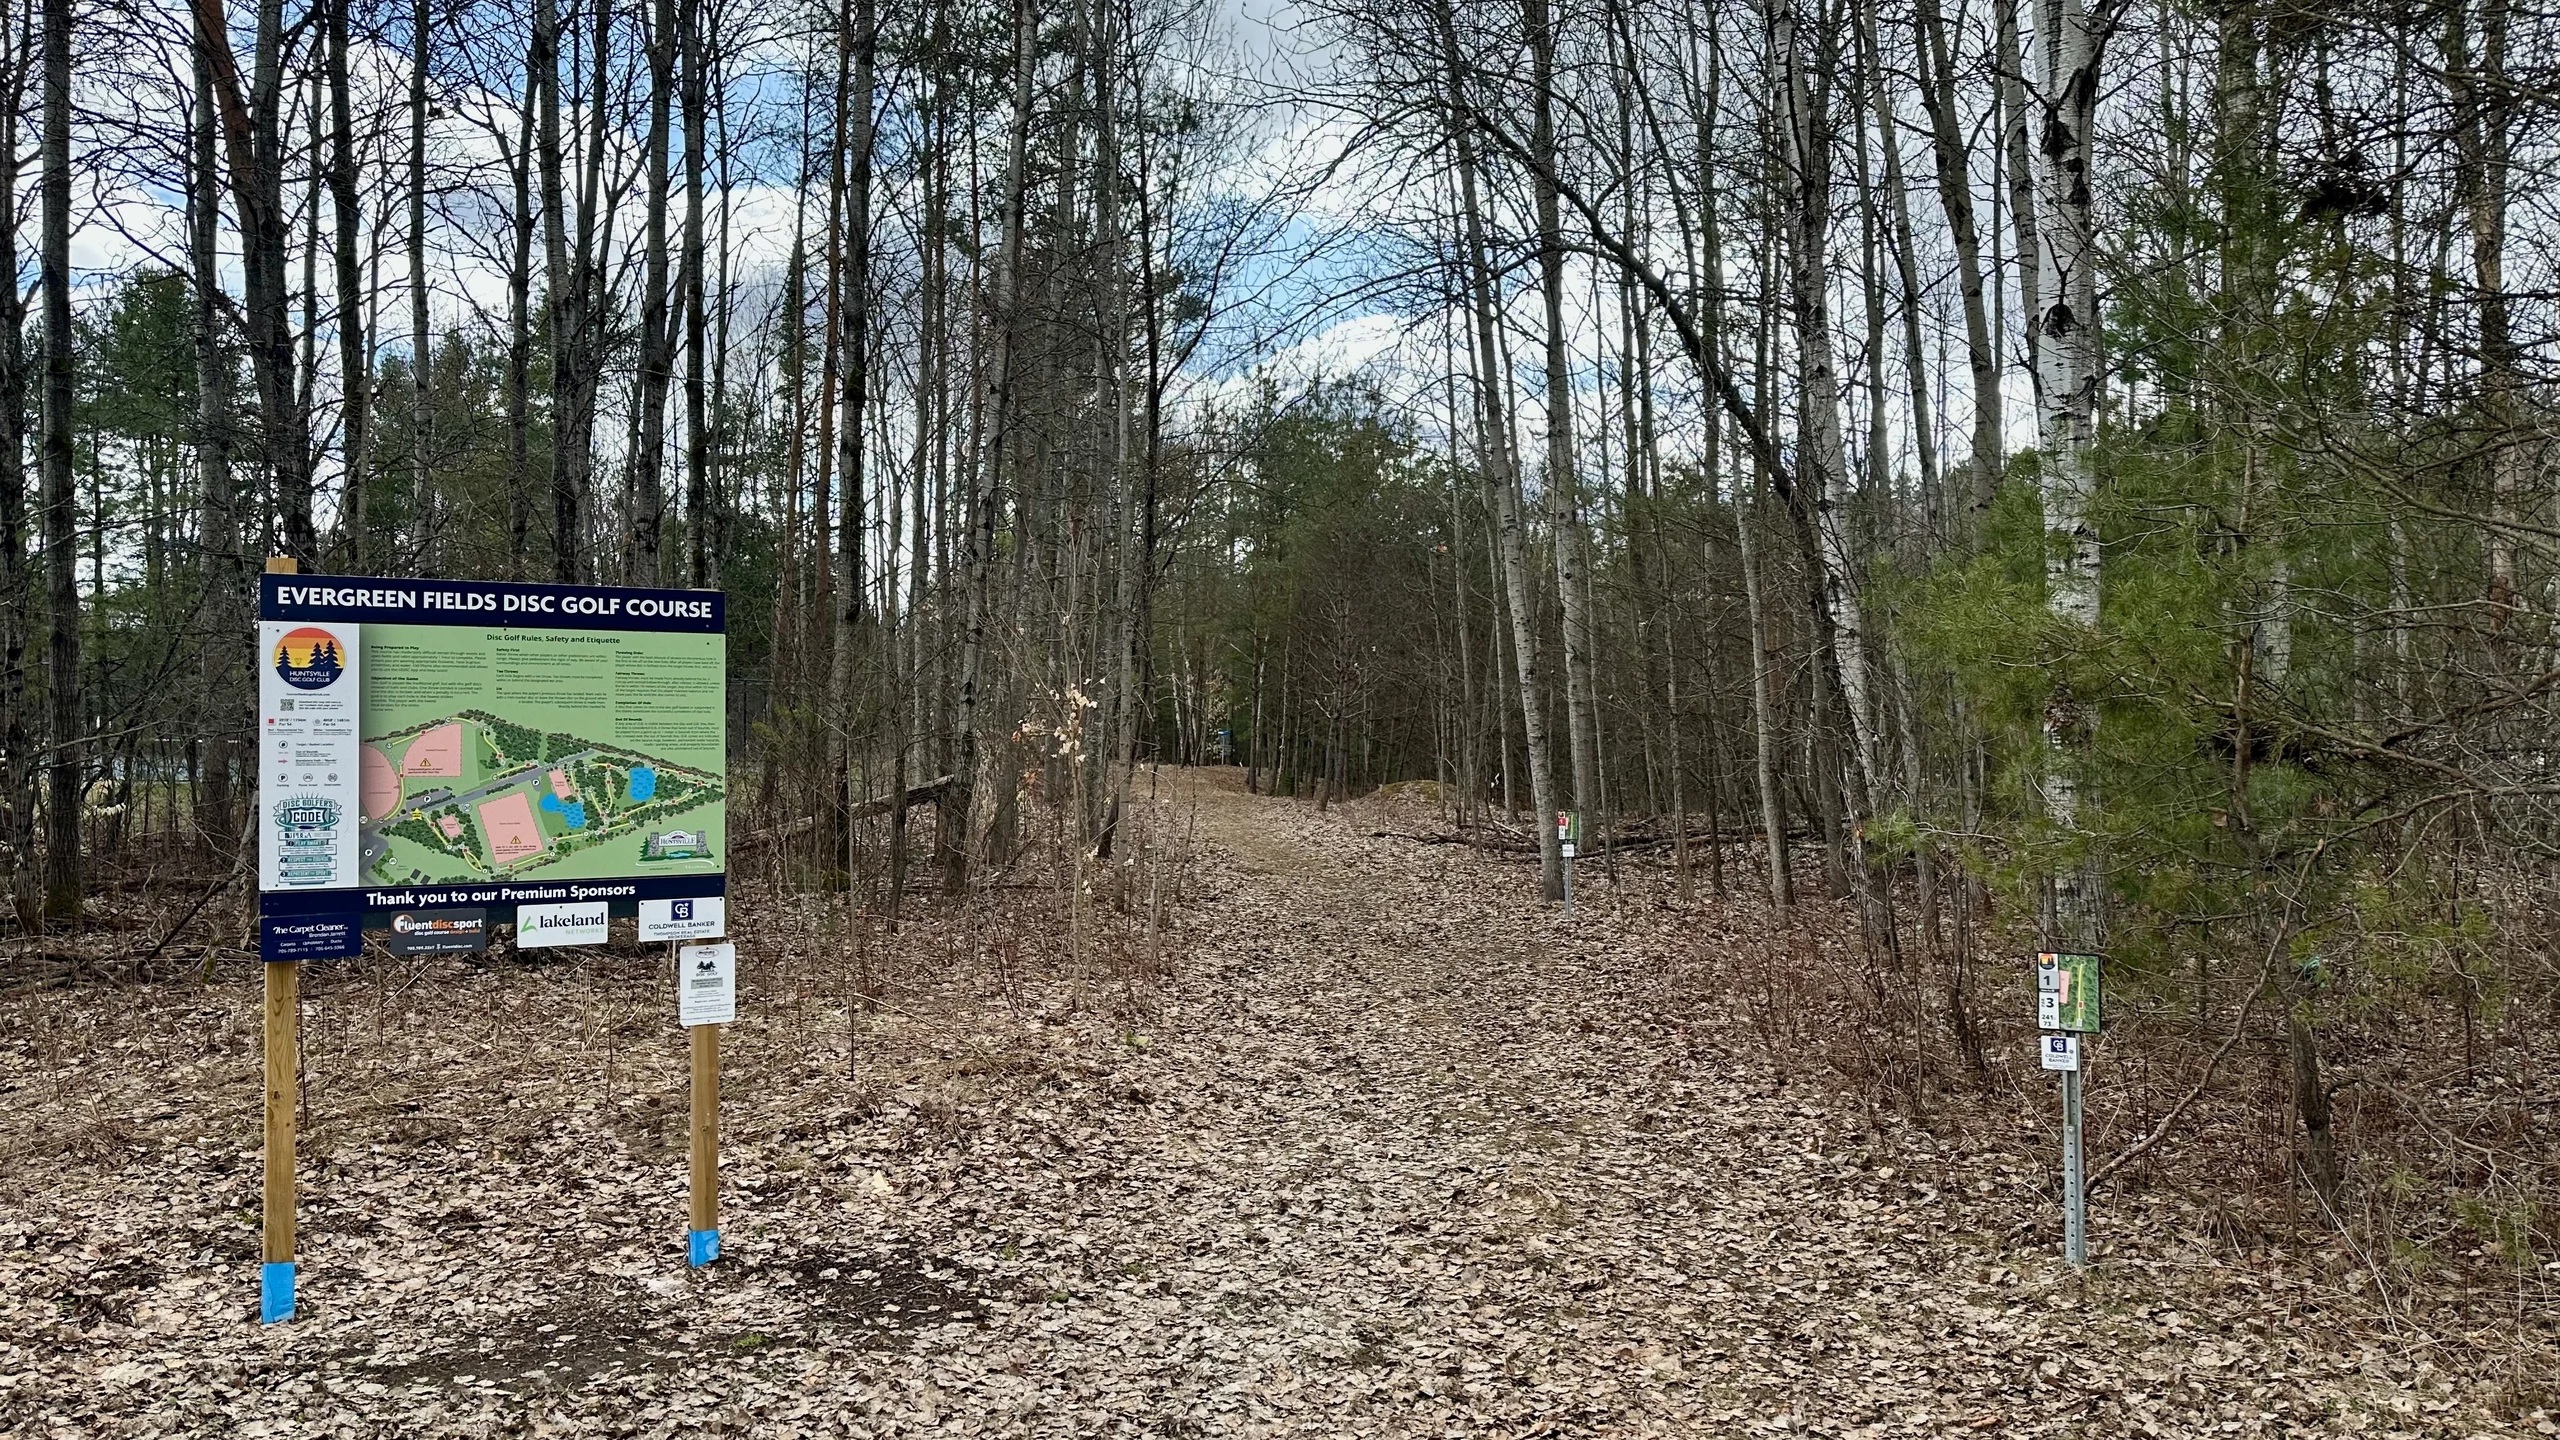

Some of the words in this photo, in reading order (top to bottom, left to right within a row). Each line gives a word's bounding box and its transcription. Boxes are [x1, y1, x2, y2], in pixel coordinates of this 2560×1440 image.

[277, 586, 417, 608] EVERGREEN
[423, 591, 497, 611] FIELDS
[503, 594, 555, 613] DISC
[561, 596, 621, 615] GOLF
[625, 599, 713, 618] COURSE
[486, 633, 502, 641] Disc
[521, 634, 544, 643] Rules,
[545, 635, 569, 645] Safety
[586, 637, 621, 645] Etiquette
[282, 799, 300, 808] DISC
[293, 811, 322, 823] CODE
[660, 837, 696, 845] HUNTSVILLE
[366, 891, 415, 906] Thank
[418, 894, 447, 908] you
[450, 890, 468, 903] to
[471, 891, 498, 902] our
[501, 886, 567, 900] Premium
[570, 884, 636, 899] Sponsors
[539, 911, 605, 928] lakeland
[648, 922, 687, 930] COLDWELL
[687, 920, 716, 928] BANKER
[272, 925, 288, 935] The
[289, 924, 315, 935] Carpet
[315, 922, 345, 932] Cleaner
[565, 927, 605, 935] NETWORKS
[2043, 975, 2051, 986] 1
[2046, 997, 2055, 1008] 3
